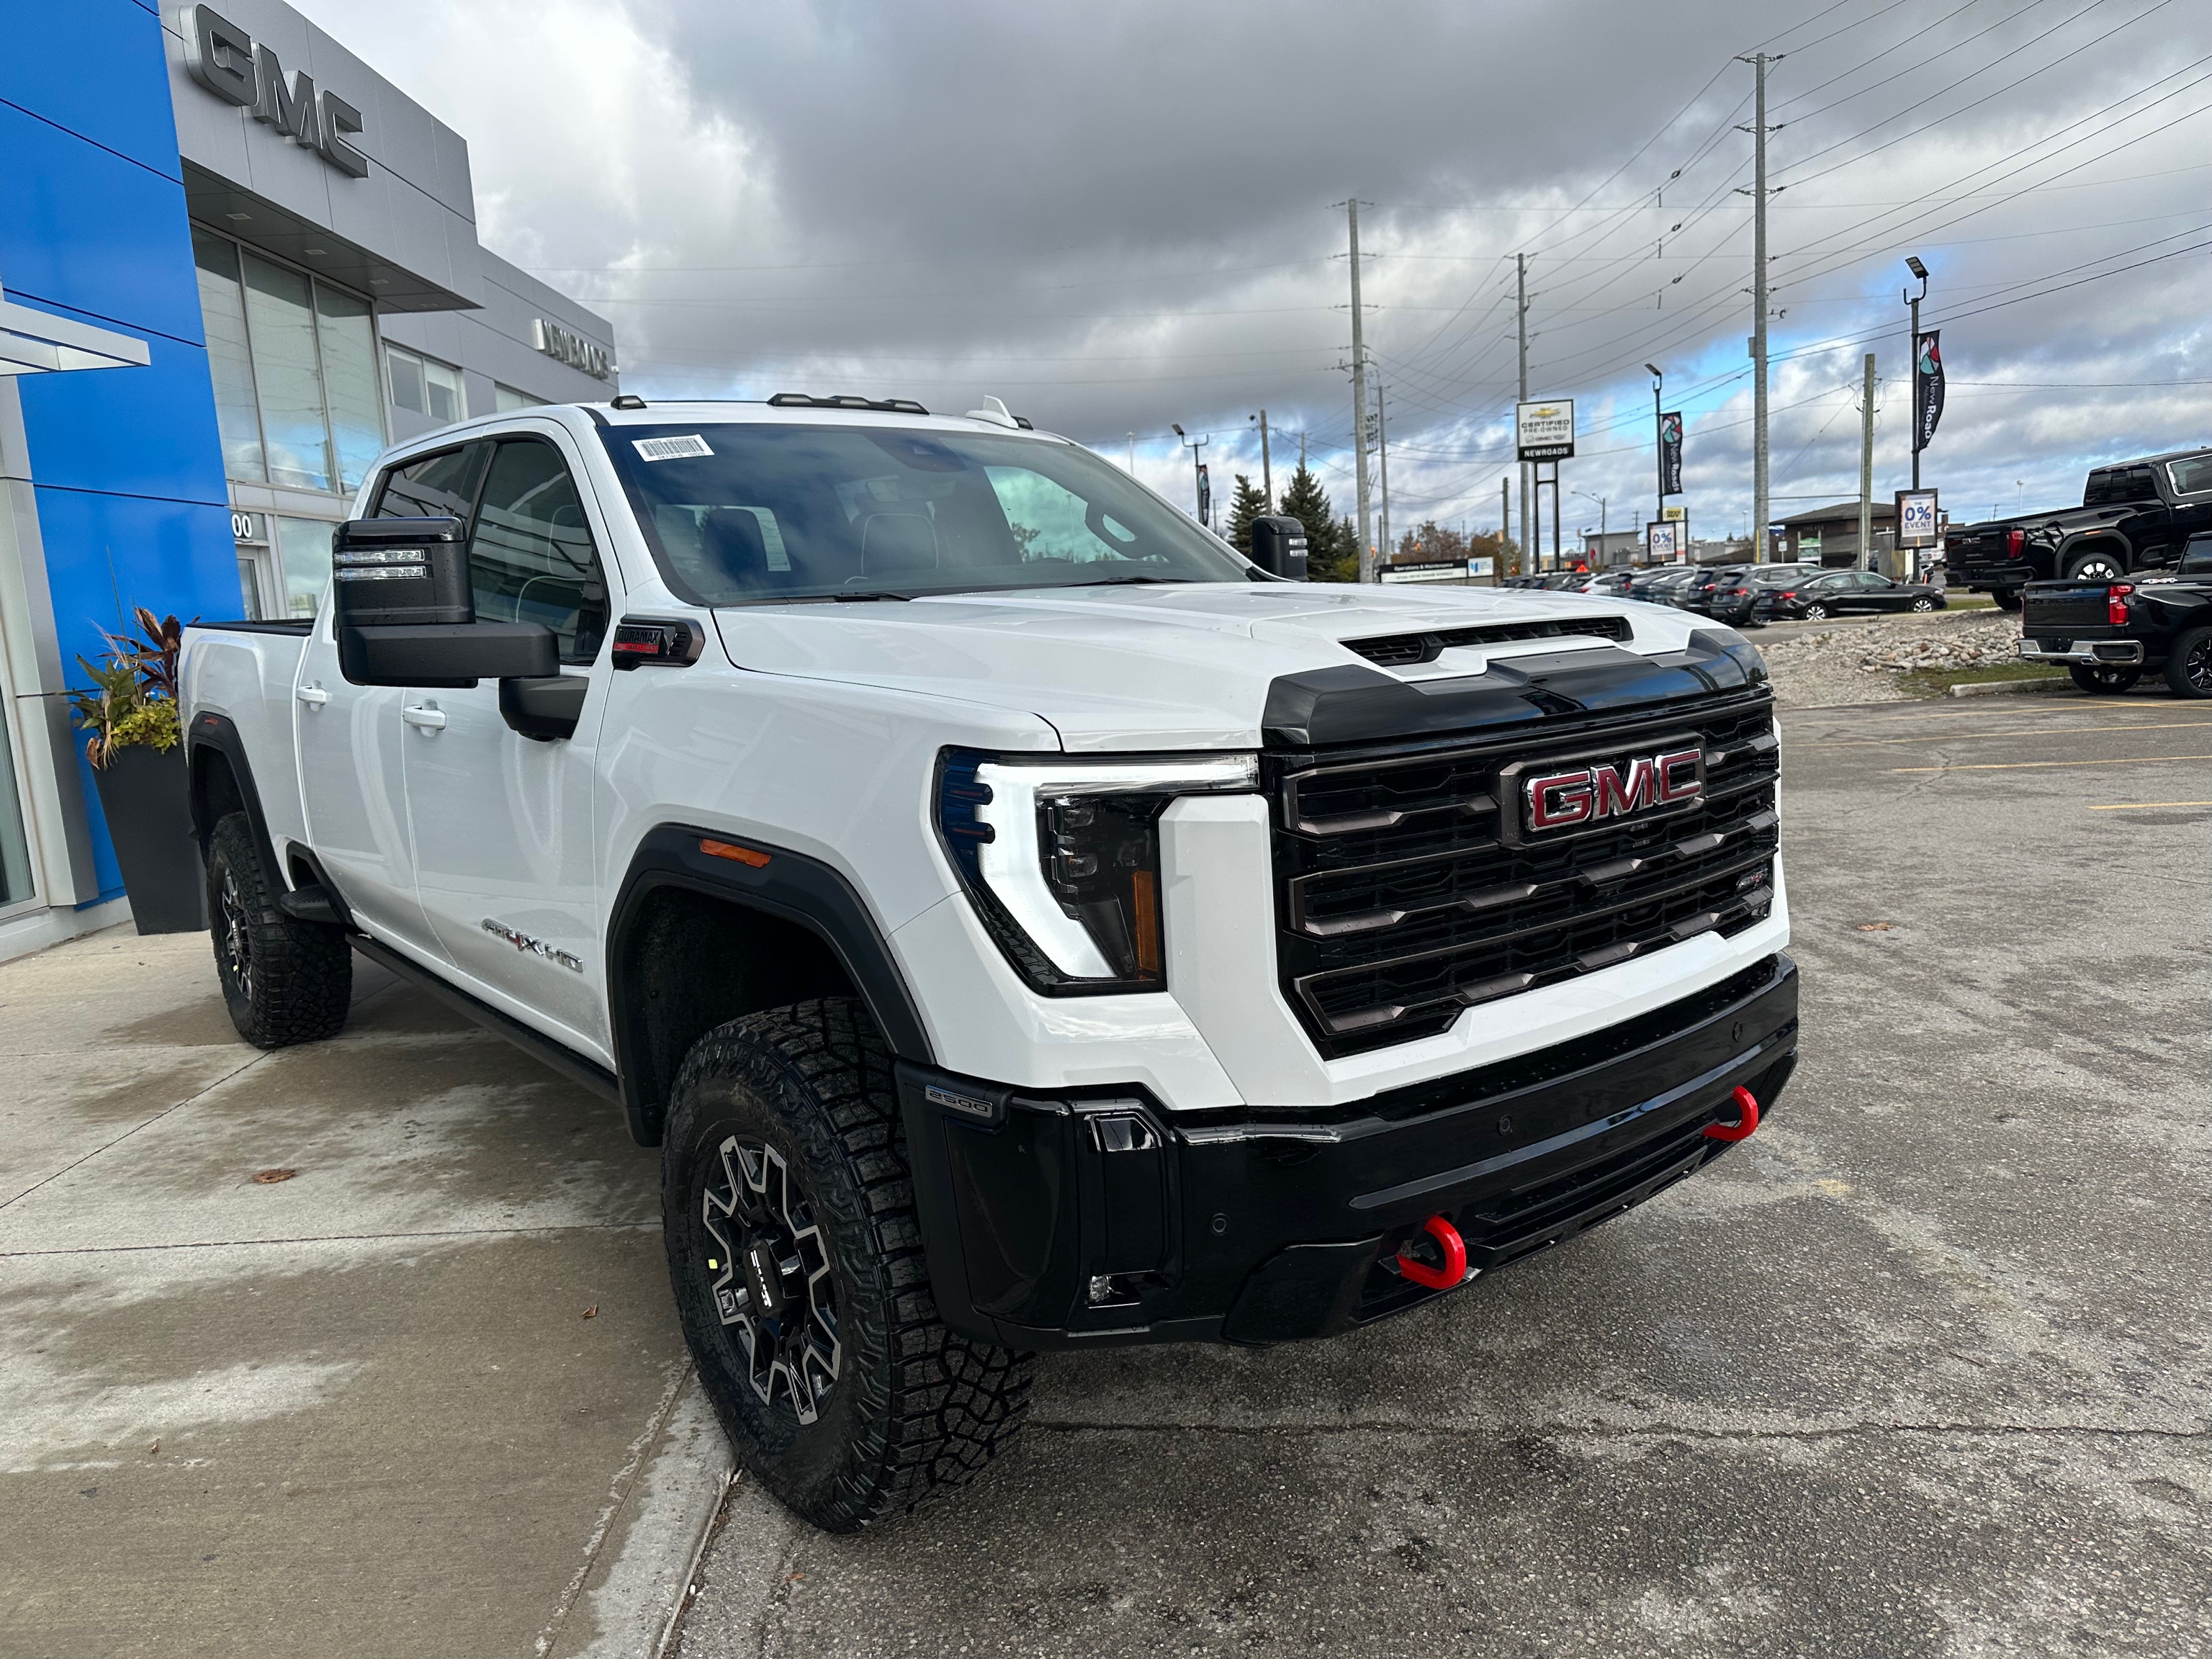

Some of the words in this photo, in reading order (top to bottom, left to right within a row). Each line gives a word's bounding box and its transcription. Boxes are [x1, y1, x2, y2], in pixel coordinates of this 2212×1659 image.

[179, 4, 369, 178] GMC
[1521, 419, 1570, 428] CERTIFIED
[1524, 446, 1568, 457] NEWROADS
[1905, 505, 1931, 521] 0%
[1905, 521, 1931, 529] EVENT
[1653, 533, 1672, 544] 0%
[619, 629, 659, 644] DURAMAX
[1527, 748, 1702, 832] GMC
[929, 1089, 989, 1112] 2500
